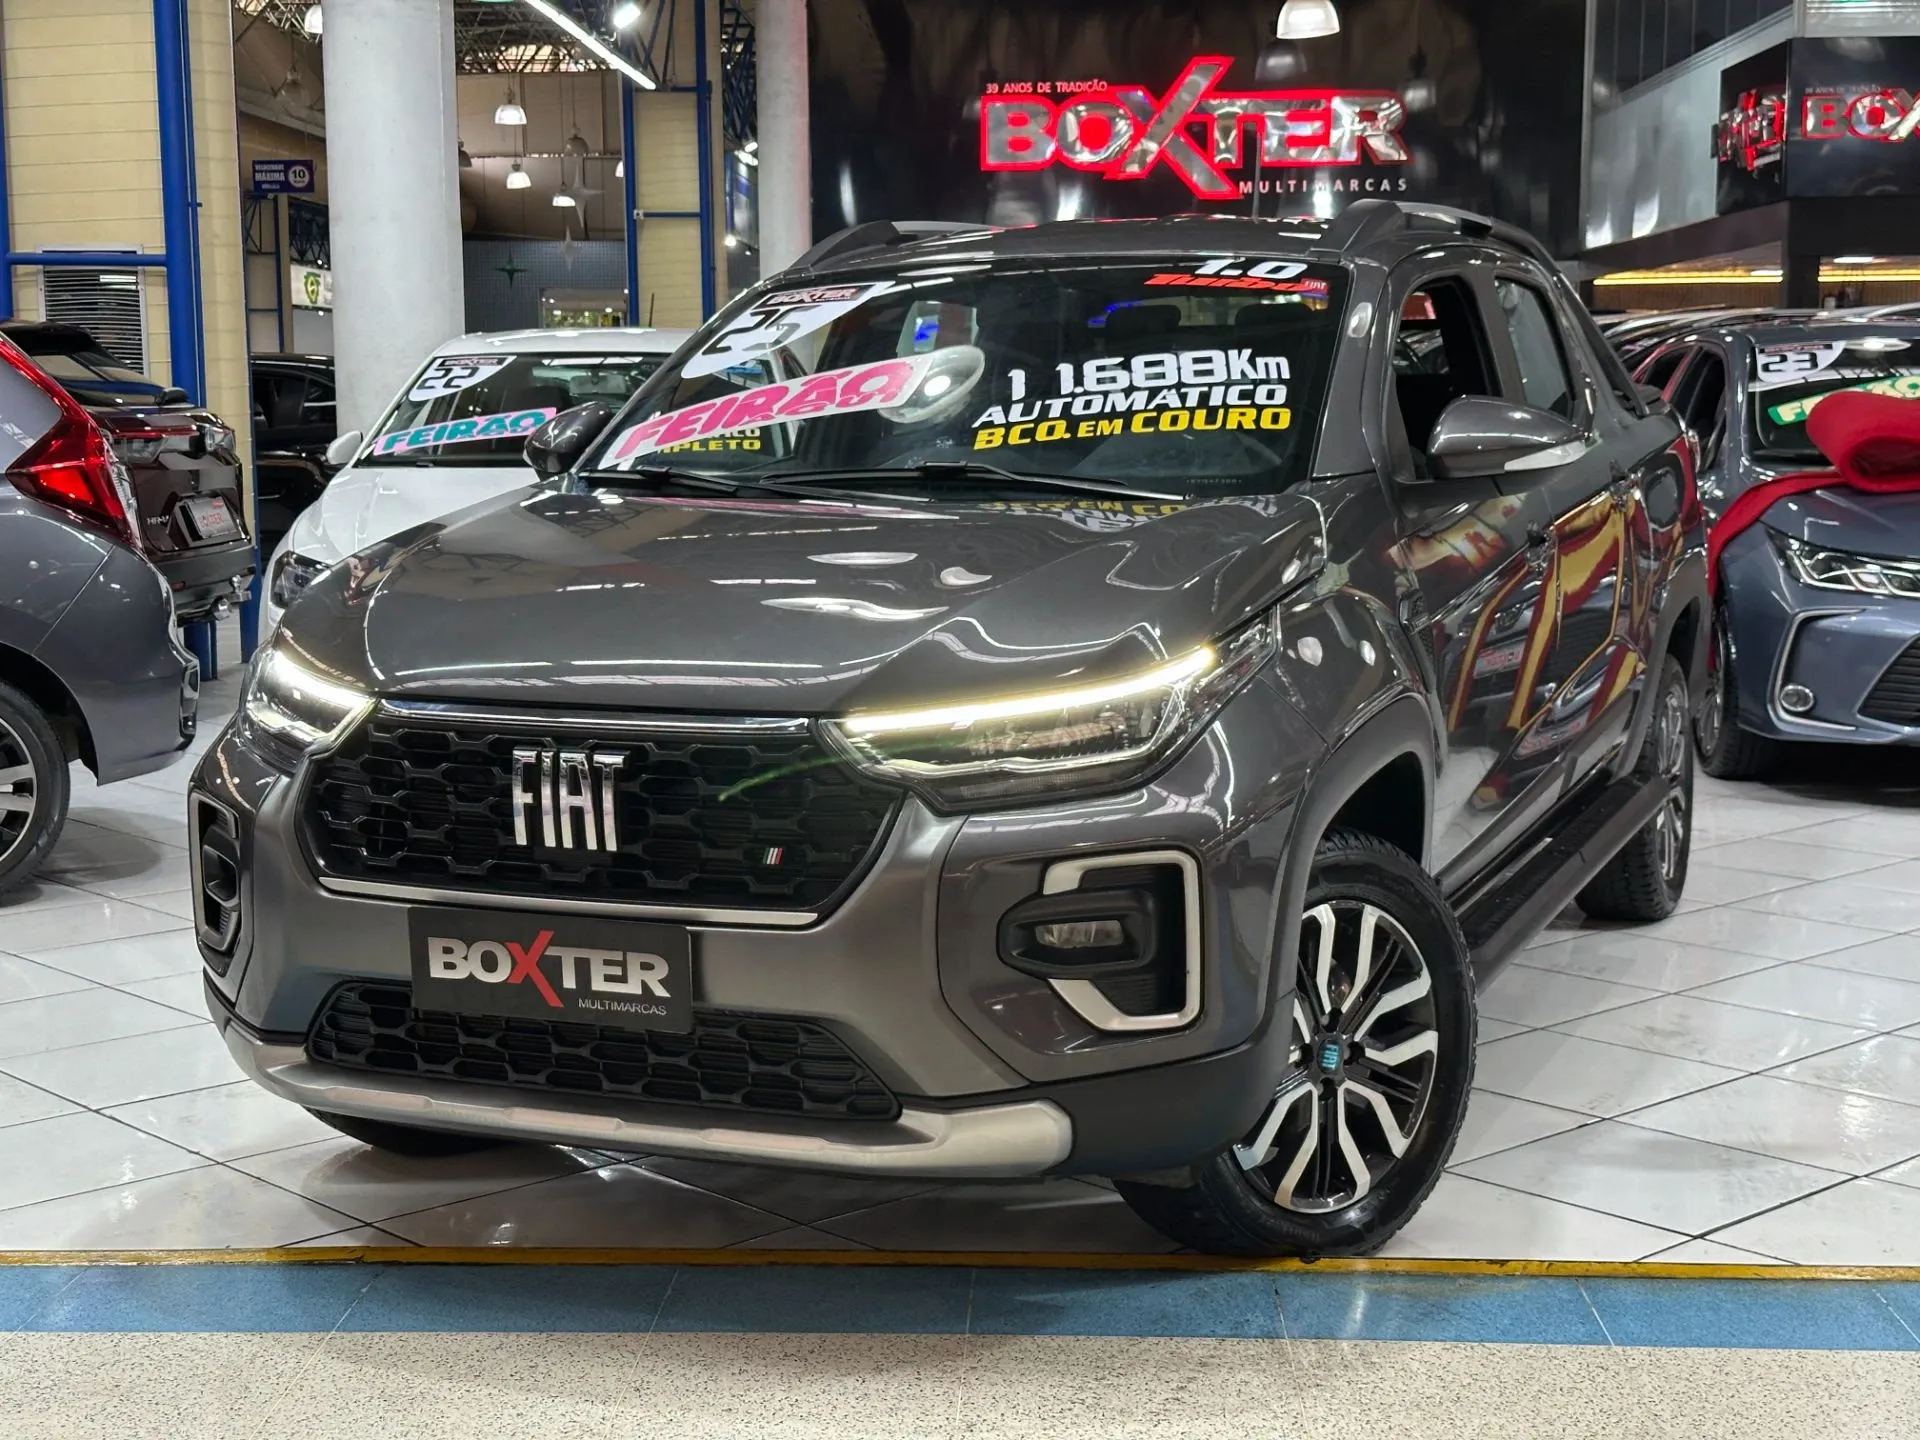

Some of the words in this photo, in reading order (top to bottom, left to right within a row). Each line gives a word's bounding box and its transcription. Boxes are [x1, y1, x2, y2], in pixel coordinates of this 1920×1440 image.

[986, 83, 998, 94] 39
[1003, 82, 1032, 93] ANOS
[1037, 82, 1051, 93] DE
[1056, 79, 1107, 93] TRADIÇÃO
[981, 56, 1413, 199] BOXTER
[291, 169, 306, 179] 10
[1239, 178, 1407, 194] MULTIMARCAS
[1195, 257, 1308, 280] 1.0
[766, 287, 860, 305] BOXTER
[1761, 351, 1819, 373] 23
[416, 366, 480, 390] 22
[1077, 418, 1124, 438] EM
[1131, 407, 1291, 433] COURO
[512, 749, 625, 851] FIAT
[427, 930, 671, 1008] BOXTER
[578, 998, 667, 1016] MULTIMARCAS
